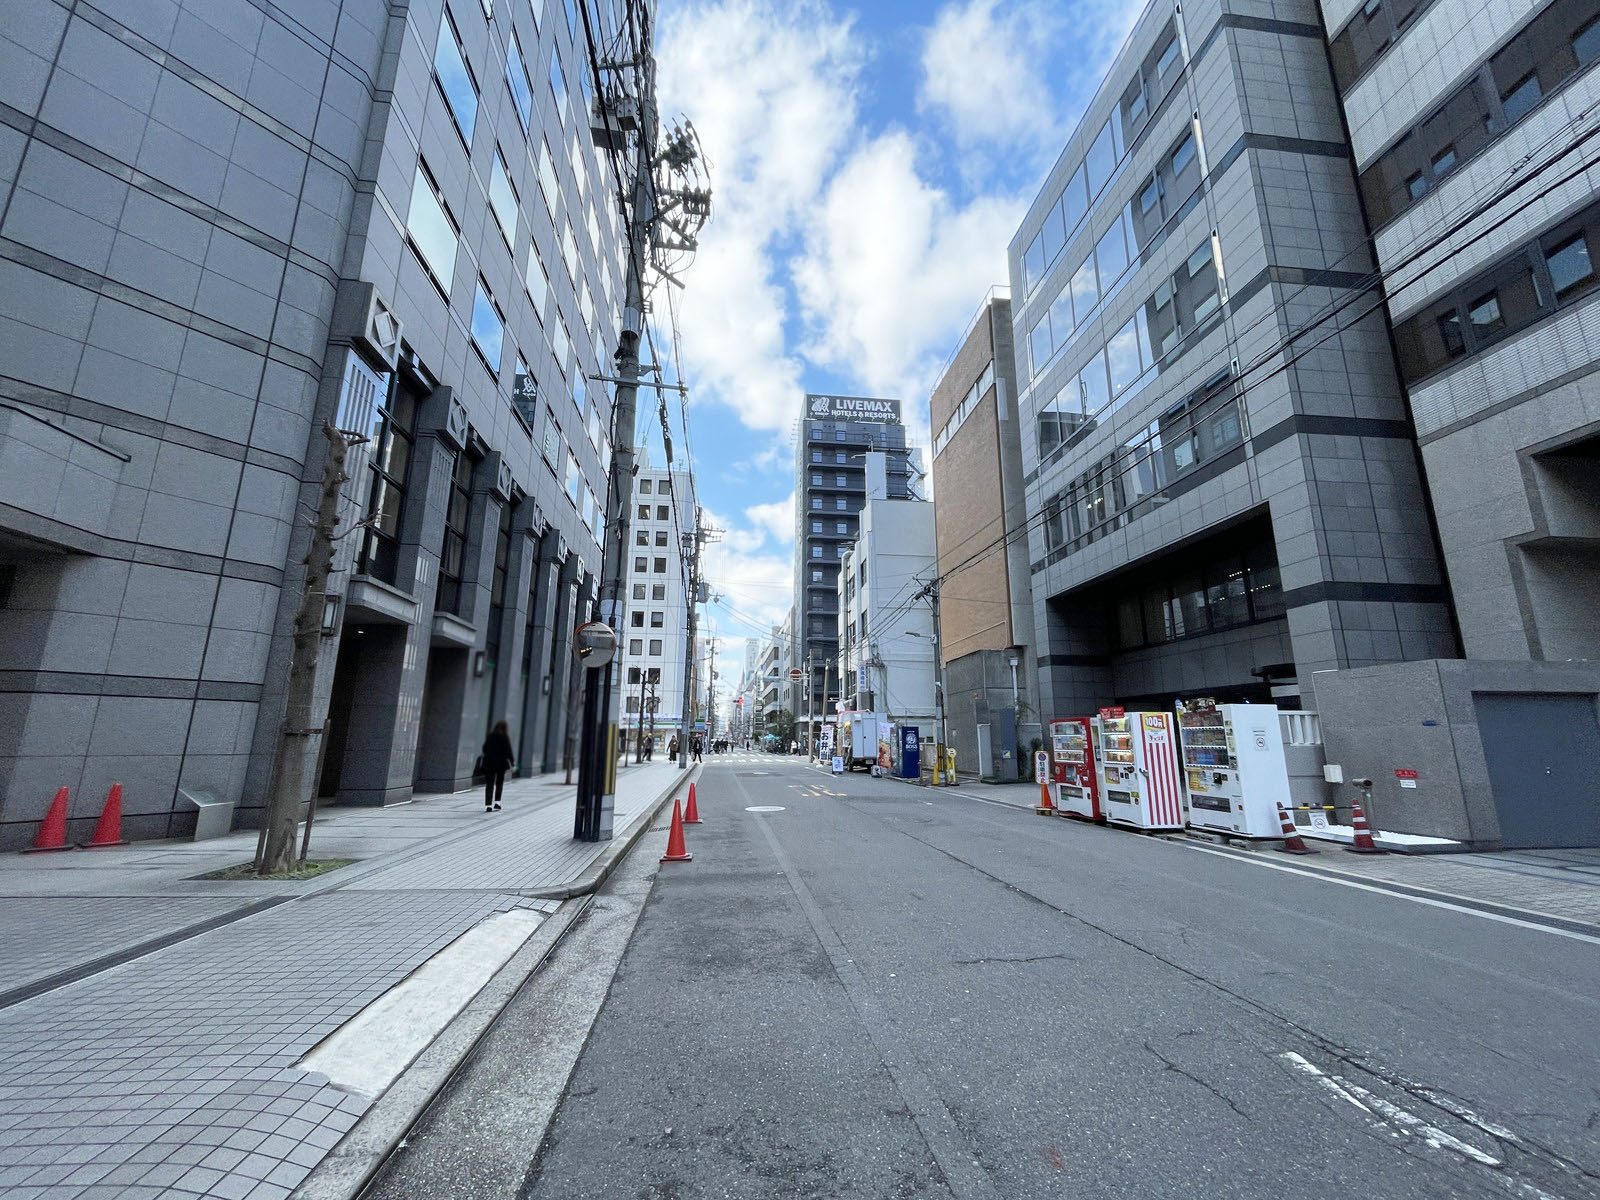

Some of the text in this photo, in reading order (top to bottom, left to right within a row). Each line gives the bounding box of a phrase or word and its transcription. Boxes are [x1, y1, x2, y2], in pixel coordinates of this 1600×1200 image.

[836, 399, 892, 412] LIVEMAX
[865, 411, 896, 419] RESORTS
[820, 732, 829, 760] お弁当
